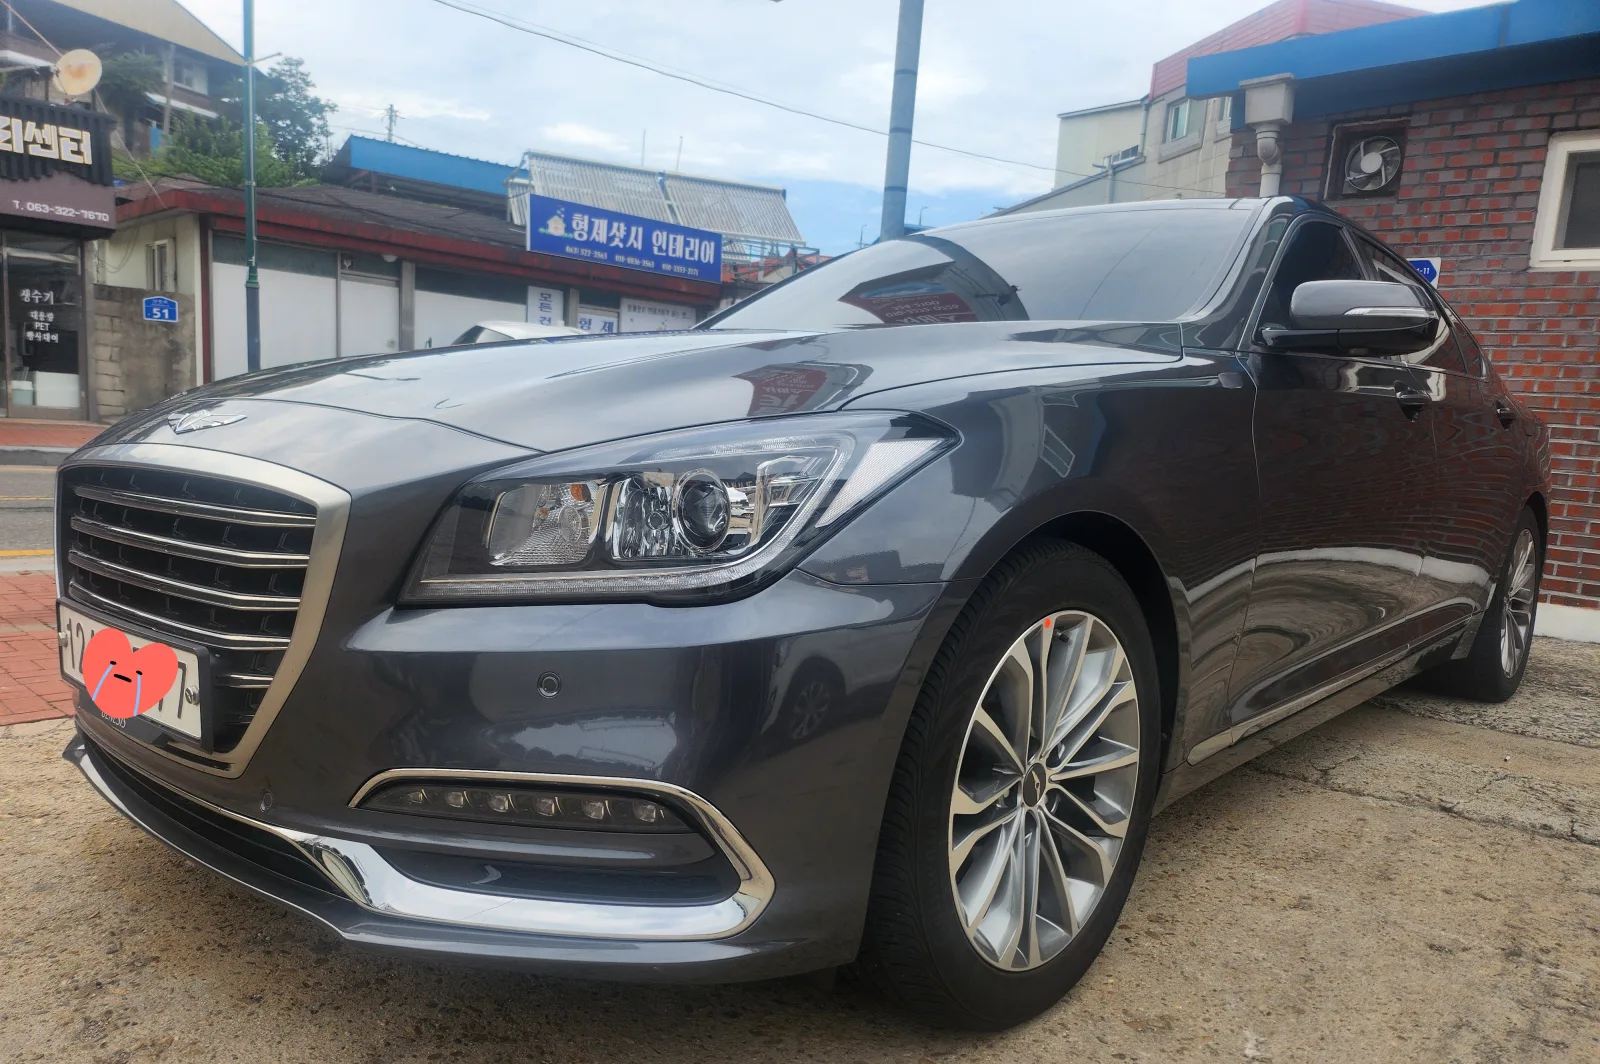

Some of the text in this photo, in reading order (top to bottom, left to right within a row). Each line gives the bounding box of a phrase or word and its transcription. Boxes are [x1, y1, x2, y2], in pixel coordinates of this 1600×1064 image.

[27, 202, 110, 222] 063-322-7670
[571, 214, 715, 264] 형제샷시 인테리어
[20, 288, 54, 305] 생수기
[538, 292, 552, 312] 모든
[152, 308, 169, 319] 51
[34, 322, 50, 331] PET
